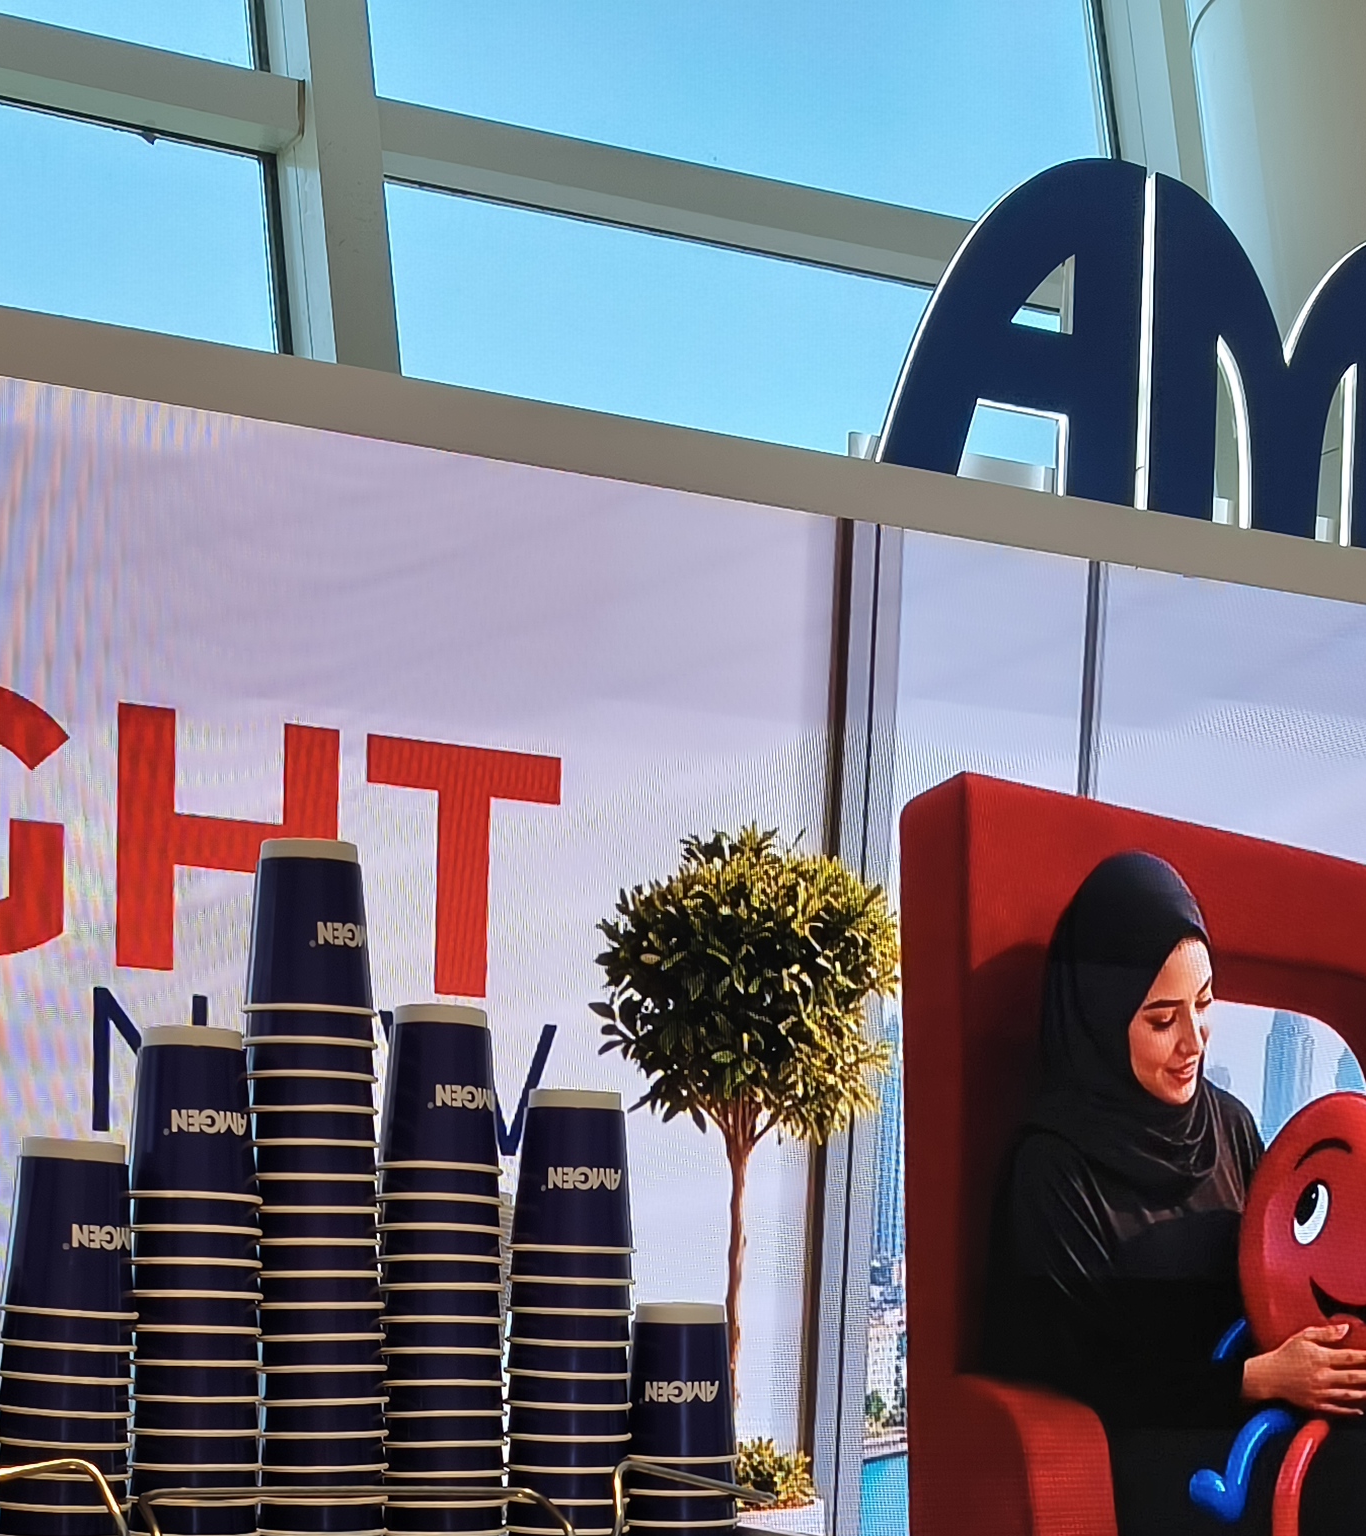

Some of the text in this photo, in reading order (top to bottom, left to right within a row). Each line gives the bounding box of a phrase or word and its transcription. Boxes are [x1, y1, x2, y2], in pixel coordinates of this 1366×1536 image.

[435, 1084, 495, 1112] MGEN
[171, 1109, 247, 1136] AMGEN
[548, 1166, 622, 1190] AMGEN
[71, 1223, 131, 1250] MGEN
[644, 1380, 719, 1404] AMGEN
